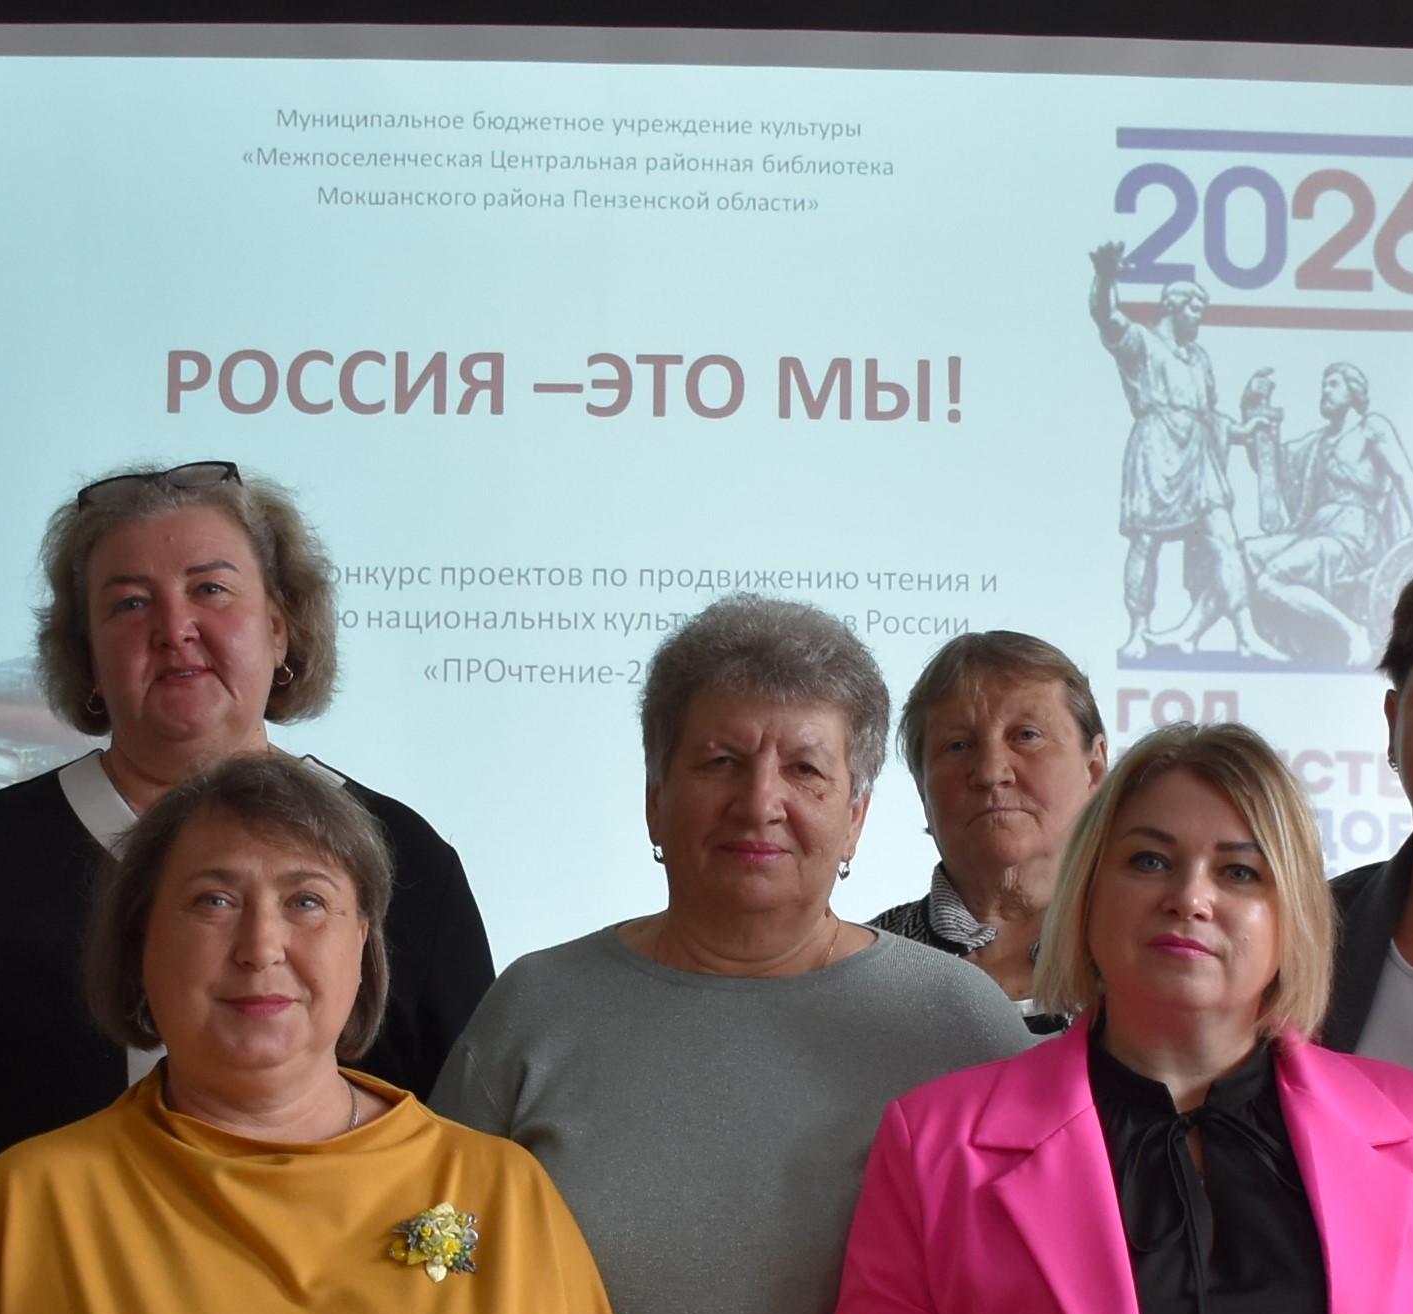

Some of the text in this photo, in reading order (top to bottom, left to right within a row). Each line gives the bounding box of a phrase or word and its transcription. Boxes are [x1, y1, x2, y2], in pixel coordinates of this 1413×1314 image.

[277, 109, 861, 140] Муниципальное бюджетное учреждение культуры
[243, 147, 893, 175] «Межпоселенческая Центральная районная библиотека
[318, 186, 818, 211] Мокшанского района Пензенской области»
[167, 349, 504, 415] РОССИЯ
[779, 356, 961, 423] МЫ!
[441, 567, 582, 591] проектов
[593, 569, 627, 586] по
[640, 569, 858, 595] продвижению
[867, 573, 968, 591] чтения
[982, 575, 996, 592] и
[368, 611, 595, 634] национальных
[867, 610, 971, 636] России
[424, 658, 642, 684] «ПРОчтение-2
